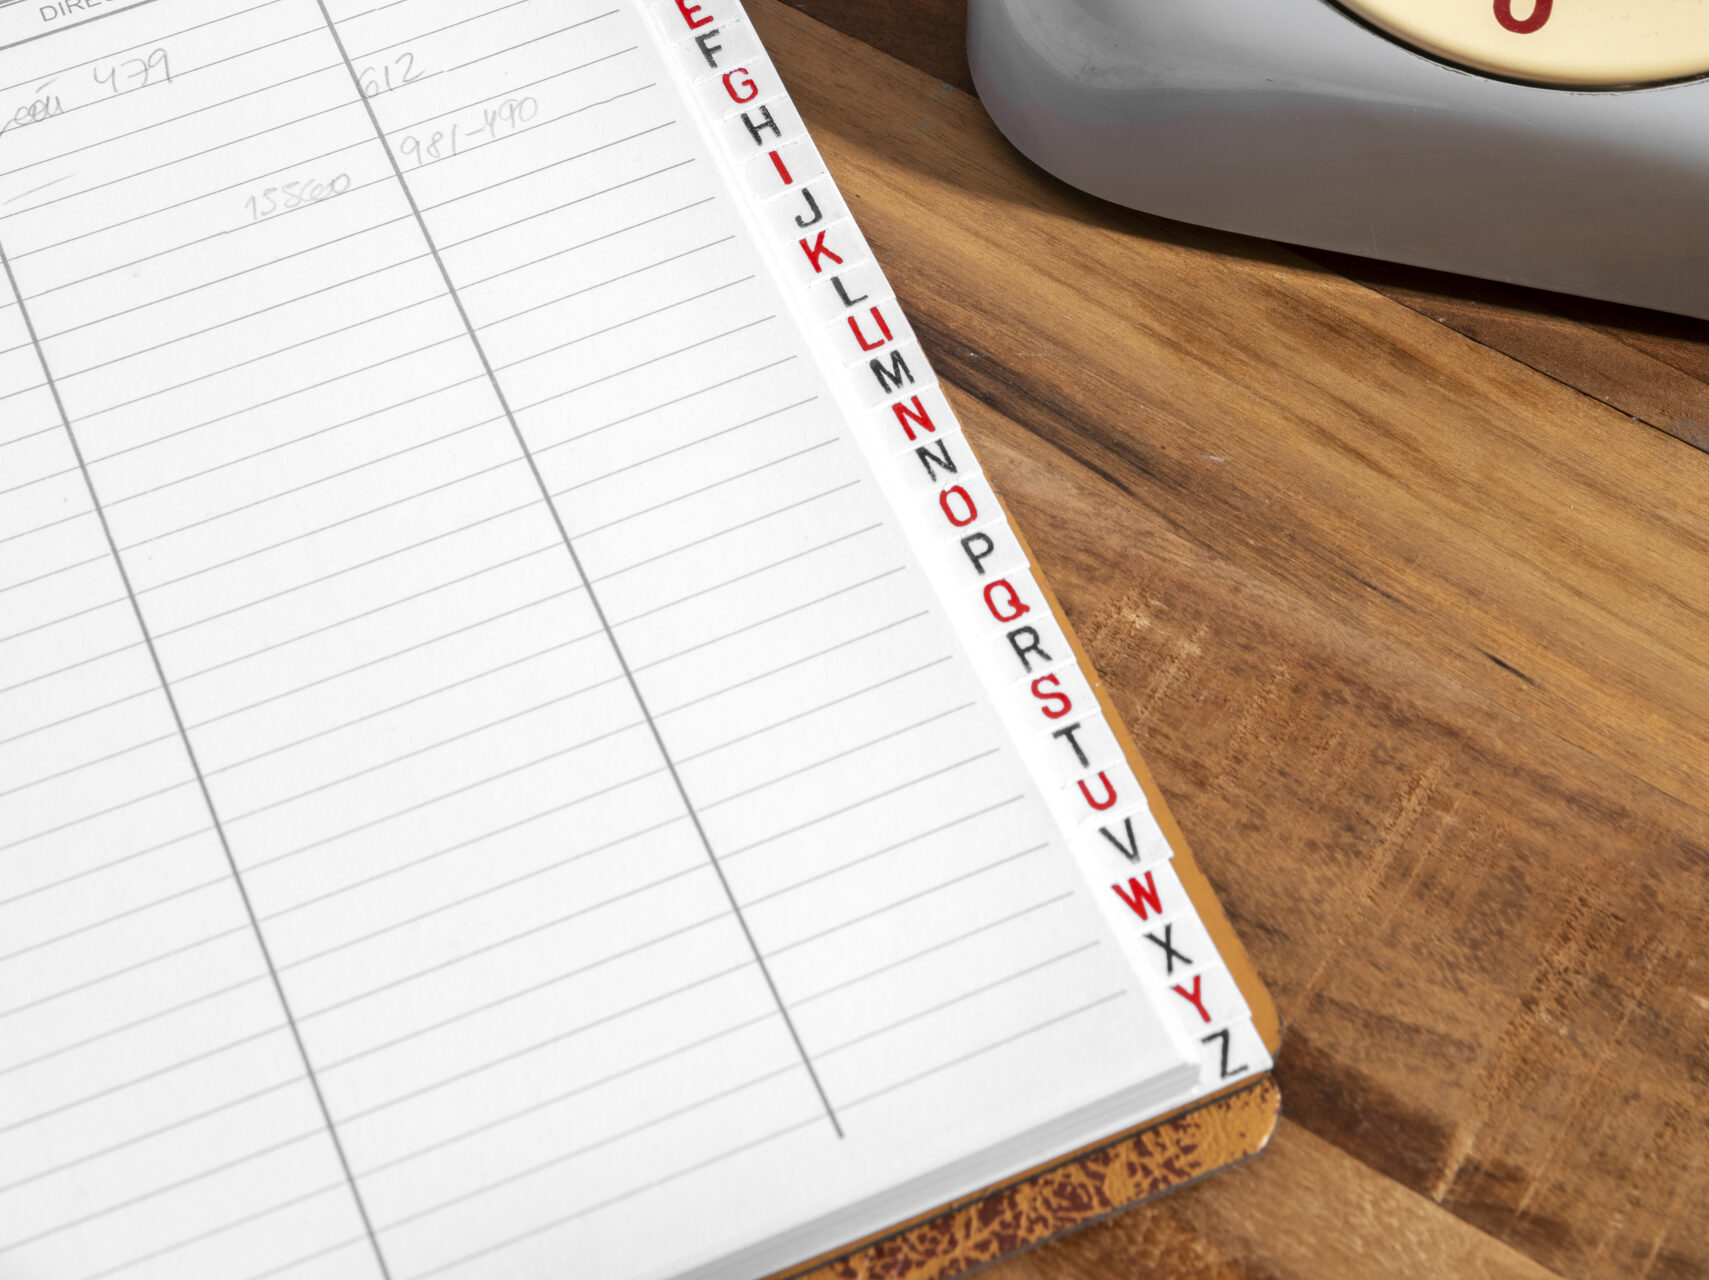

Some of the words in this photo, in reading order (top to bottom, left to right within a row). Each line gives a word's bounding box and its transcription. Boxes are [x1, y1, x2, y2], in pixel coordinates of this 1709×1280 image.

[694, 28, 723, 69] F
[721, 66, 759, 104] G
[740, 104, 782, 147] H
[768, 150, 793, 185] I
[794, 187, 823, 229] J
[799, 230, 844, 274] K
[830, 276, 869, 308] L
[869, 349, 916, 394] M
[891, 395, 937, 442] N
[914, 438, 958, 483] N
[939, 484, 979, 528] O
[960, 532, 996, 576] P
[983, 578, 1032, 624] Q
[1006, 625, 1054, 674] R
[1031, 673, 1074, 720] S
[1052, 722, 1090, 769] T
[1077, 771, 1119, 811] U
[1099, 817, 1141, 862] V
[1111, 871, 1165, 921] W
[1143, 923, 1193, 975] X
[1172, 974, 1212, 1024] Y
[1201, 1028, 1249, 1080] Z
